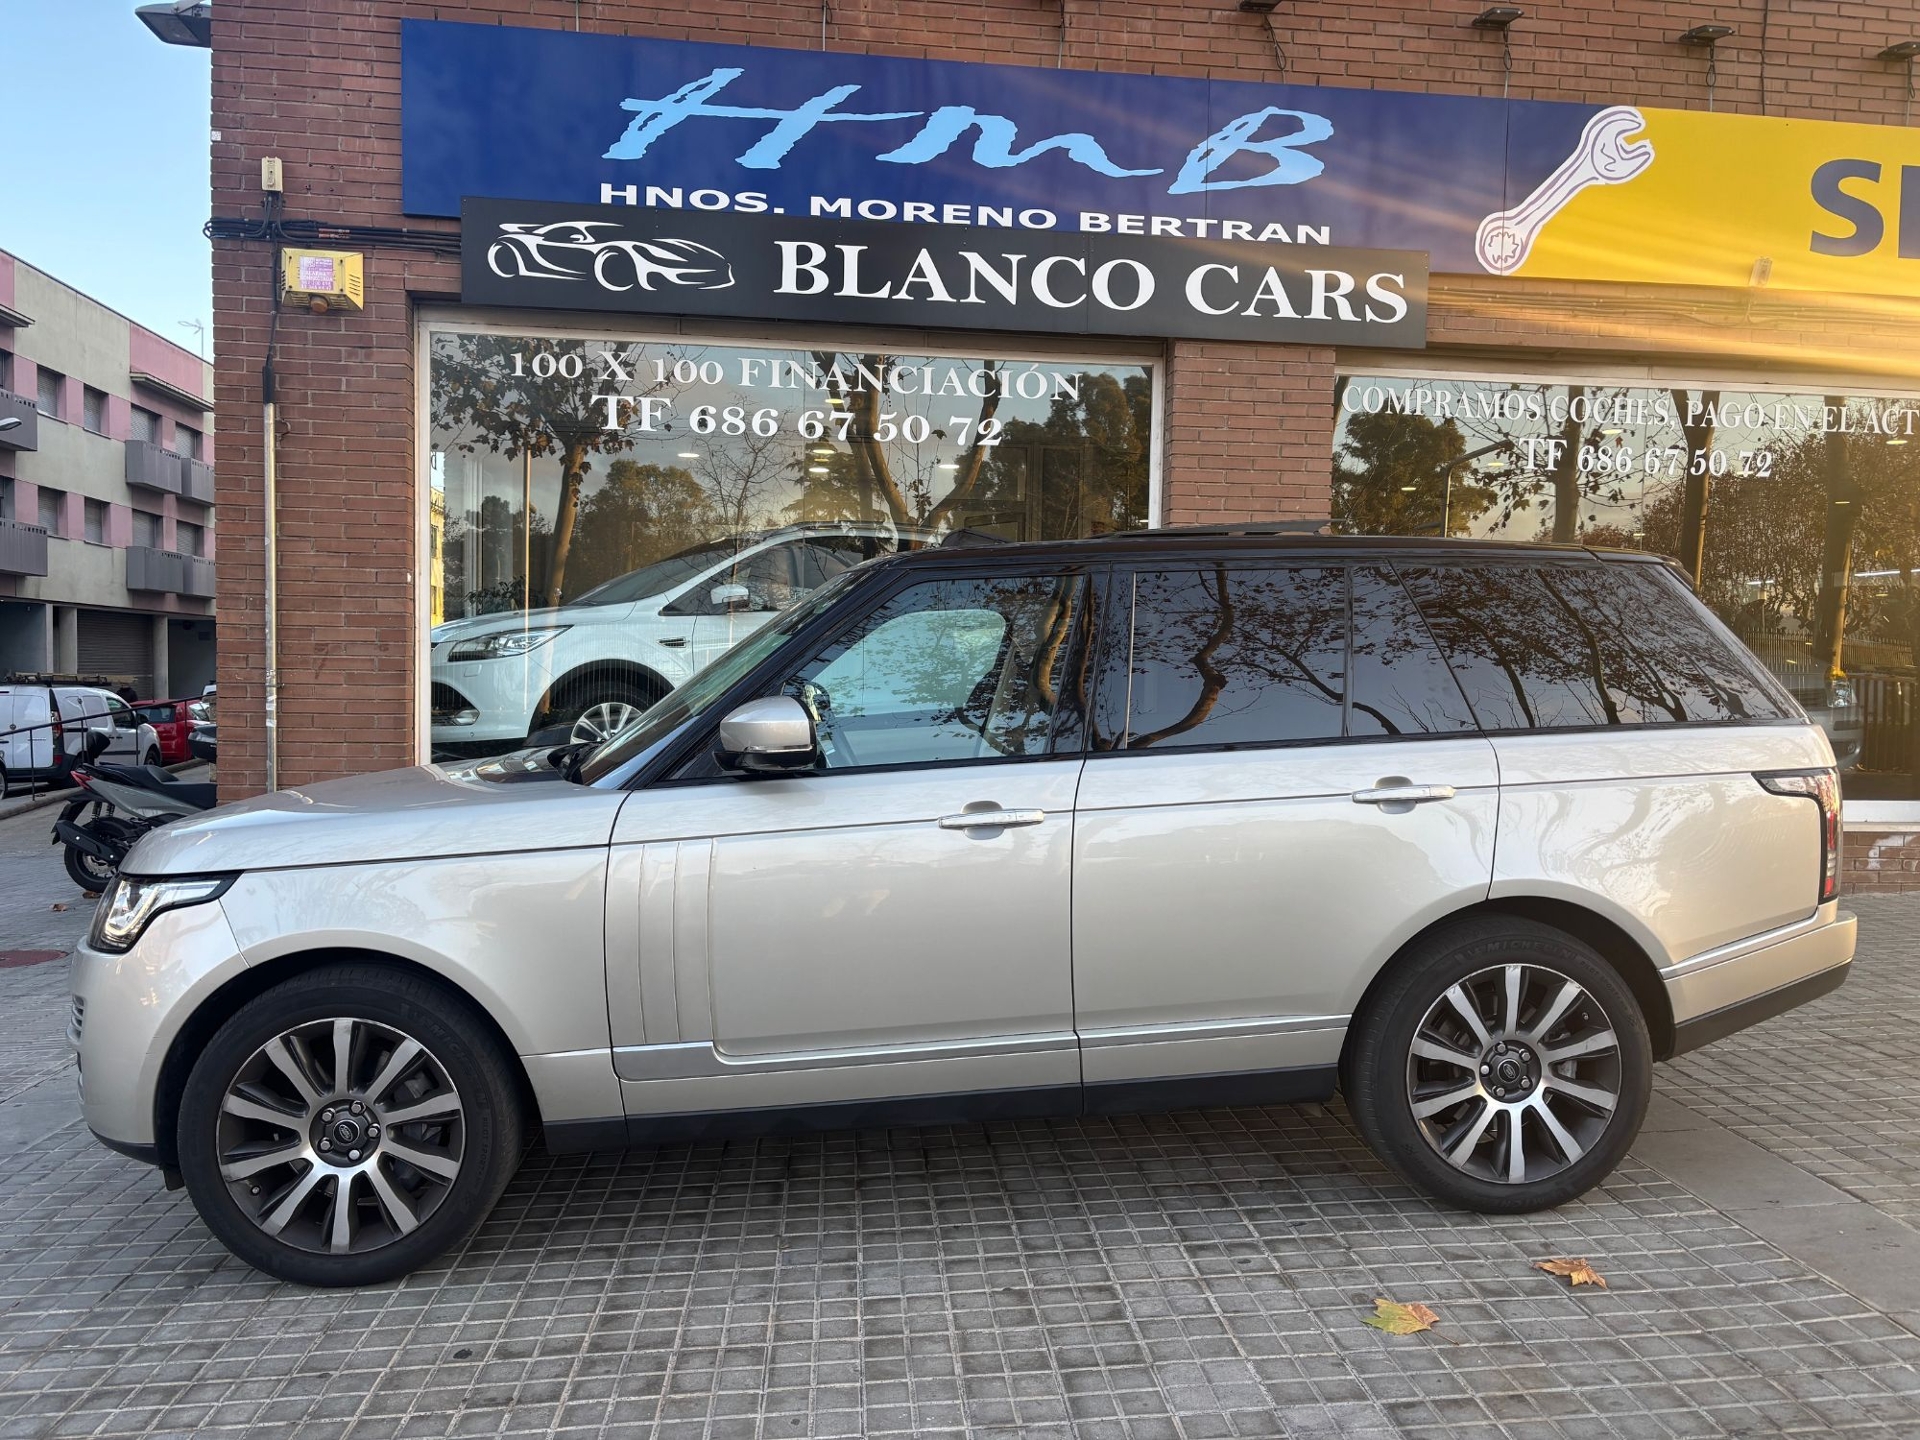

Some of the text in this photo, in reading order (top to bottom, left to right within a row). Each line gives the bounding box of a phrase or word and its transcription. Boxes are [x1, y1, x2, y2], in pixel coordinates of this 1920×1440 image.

[600, 183, 1330, 246] HNOS. MORENO BERTRAN
[773, 240, 1408, 324] BLANCO CARS
[511, 352, 1082, 400] 100 X 100 FINANCIACIÓN
[590, 394, 1003, 446] TF 686 67 50 72
[1342, 385, 1541, 421] COMPRAMOS
[1550, 396, 1676, 430] COCHES,
[1685, 401, 1766, 430] PAGO
[1773, 403, 1813, 432] EN
[1820, 405, 1857, 433] EL
[1519, 438, 1773, 478] TF 686 67 50 72
